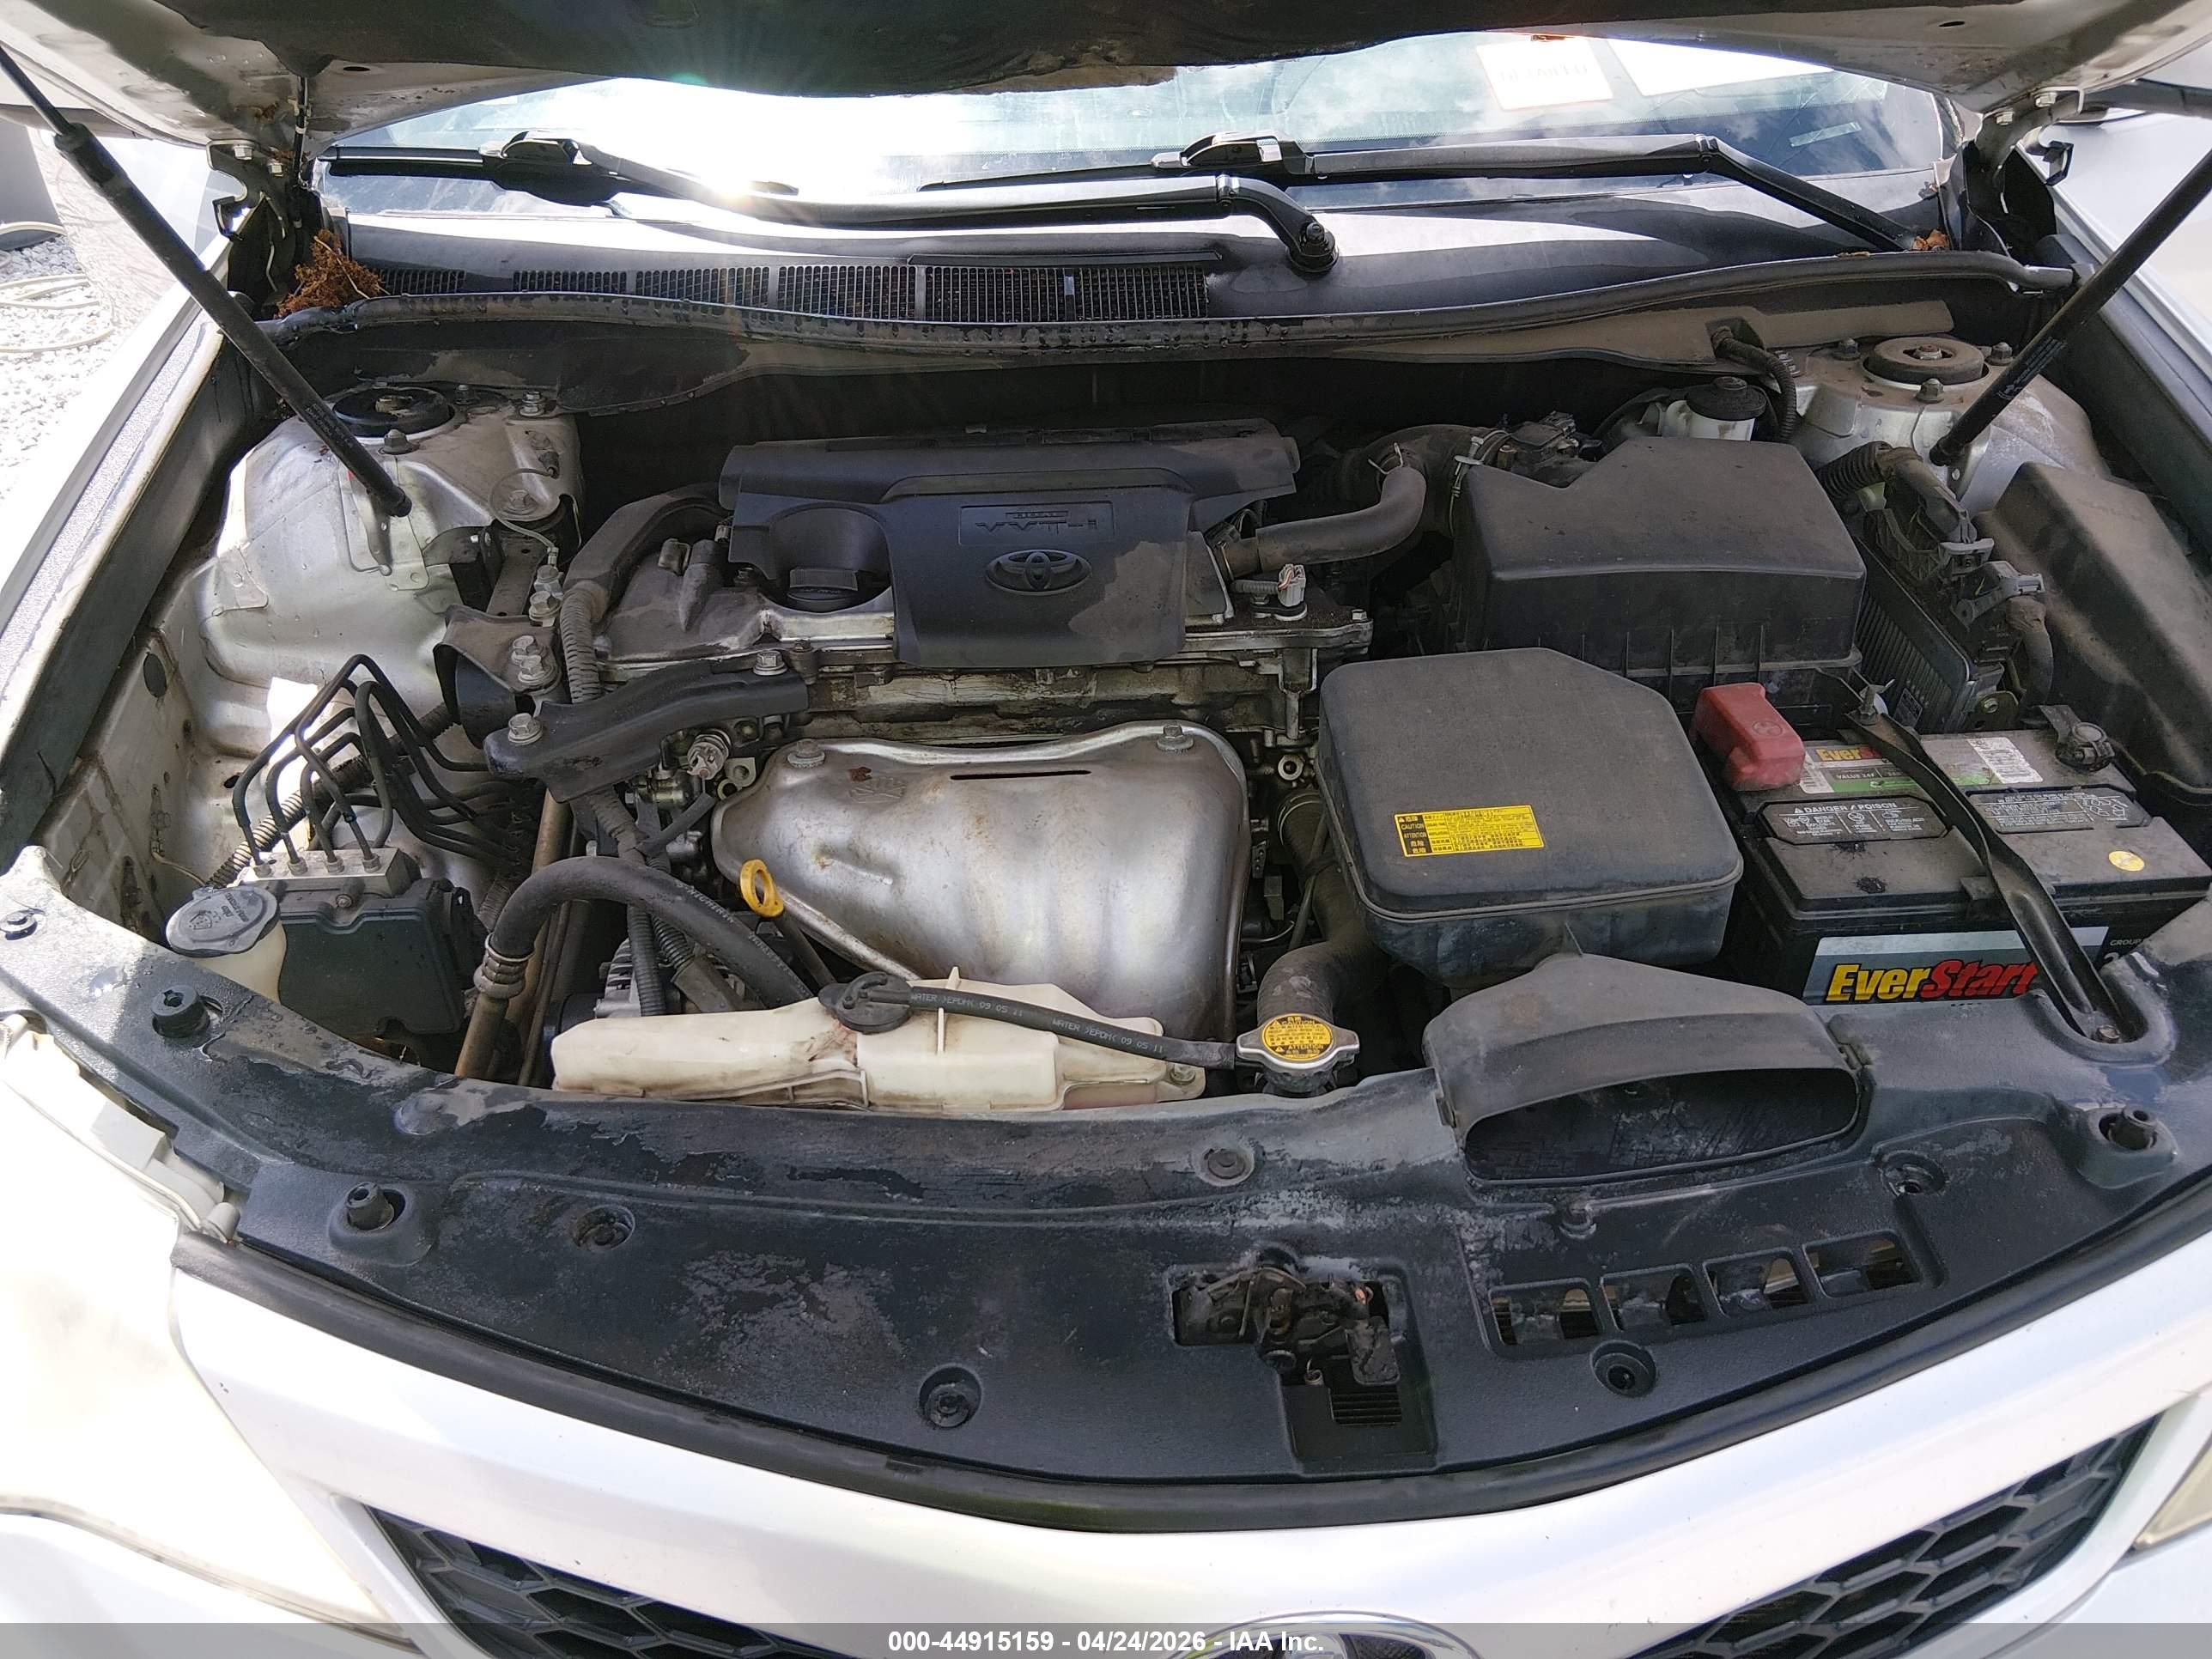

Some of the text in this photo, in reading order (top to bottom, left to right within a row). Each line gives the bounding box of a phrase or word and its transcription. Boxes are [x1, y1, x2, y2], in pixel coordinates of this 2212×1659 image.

[1803, 805, 1848, 814] DANGER
[1858, 802, 1898, 811] POISON
[2109, 938, 2142, 946] GROUP
[1826, 958, 2039, 1002] EverStart
[979, 1001, 991, 1010] 09
[995, 1004, 1008, 1013] 05
[1053, 1018, 1080, 1031] WATER
[1120, 1036, 1132, 1045] 09
[1136, 1040, 1148, 1049] 05
